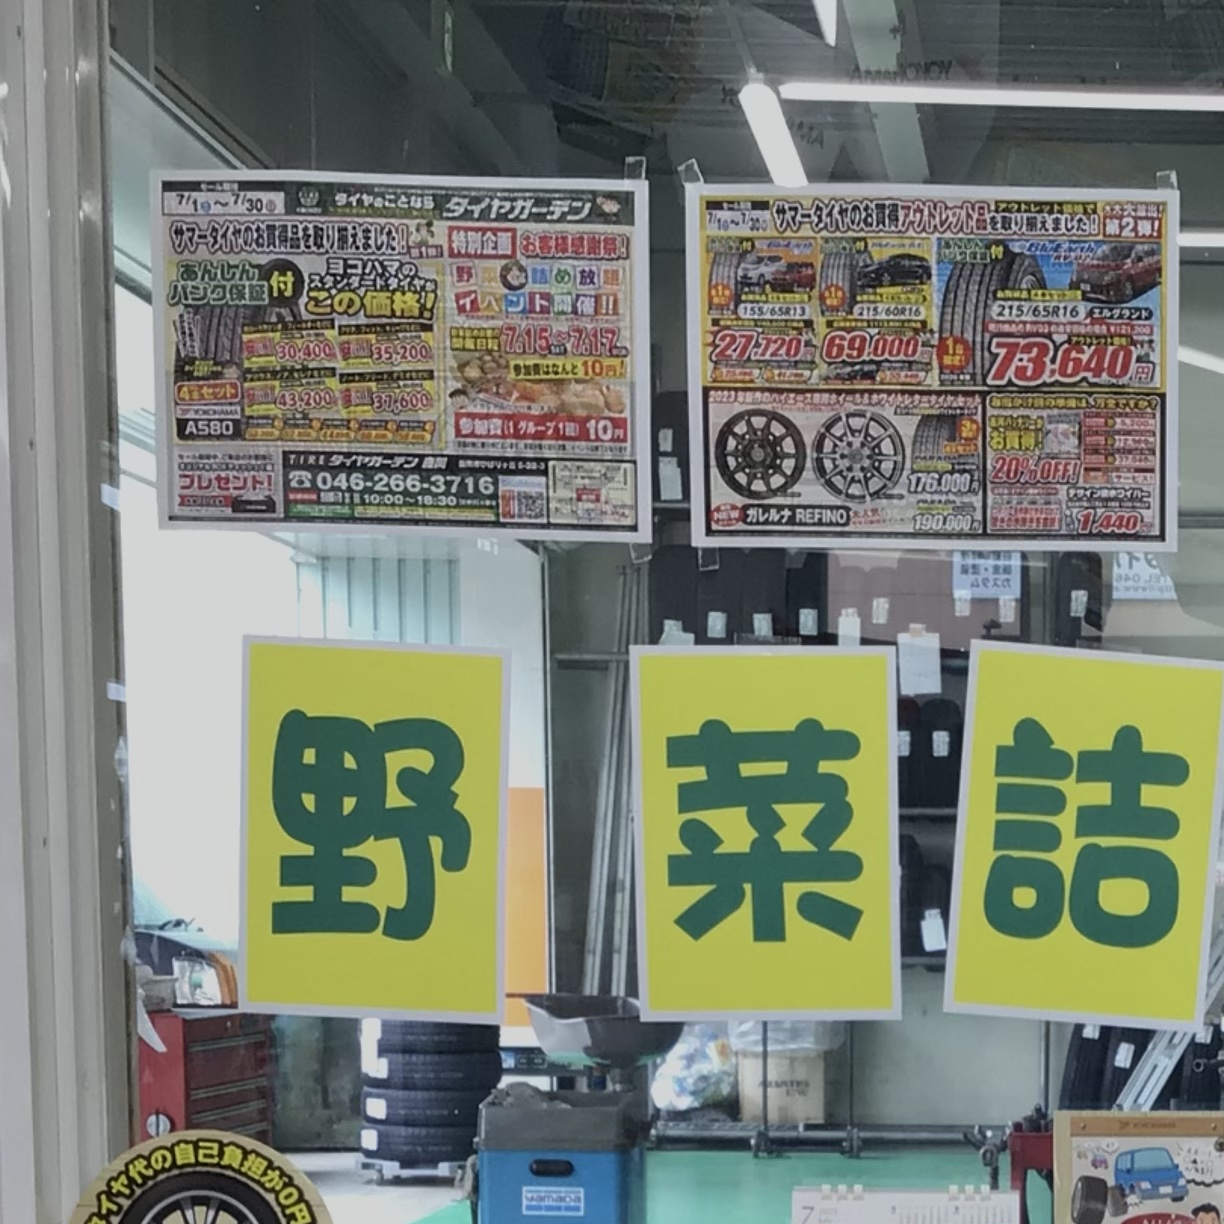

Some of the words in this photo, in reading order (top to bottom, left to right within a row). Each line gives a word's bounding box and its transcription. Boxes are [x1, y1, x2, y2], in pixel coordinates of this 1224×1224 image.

[443, 198, 592, 220] タイヤガーデン
[452, 230, 513, 256] 特別企画
[1026, 242, 1099, 253] BluEarth
[178, 261, 258, 283] あんしん
[168, 281, 268, 305] パンク保証
[270, 271, 295, 297] 付
[743, 307, 806, 317] 155/65R13
[857, 307, 921, 317] 215/60R16
[996, 304, 1080, 317] 215/65R16
[1092, 309, 1150, 319] エルグランド
[193, 407, 240, 417] YOKOHAMA
[184, 421, 234, 436] A580
[329, 455, 419, 468] タイヤガーデン
[317, 474, 495, 495] 046-266-3716
[713, 510, 740, 519] NEW
[746, 509, 792, 523] ガレルナ
[795, 509, 847, 524] REFINO
[272, 708, 471, 940] 野
[666, 717, 863, 941] 菜
[983, 717, 1189, 948] 詰
[802, 1206, 814, 1224] 7
